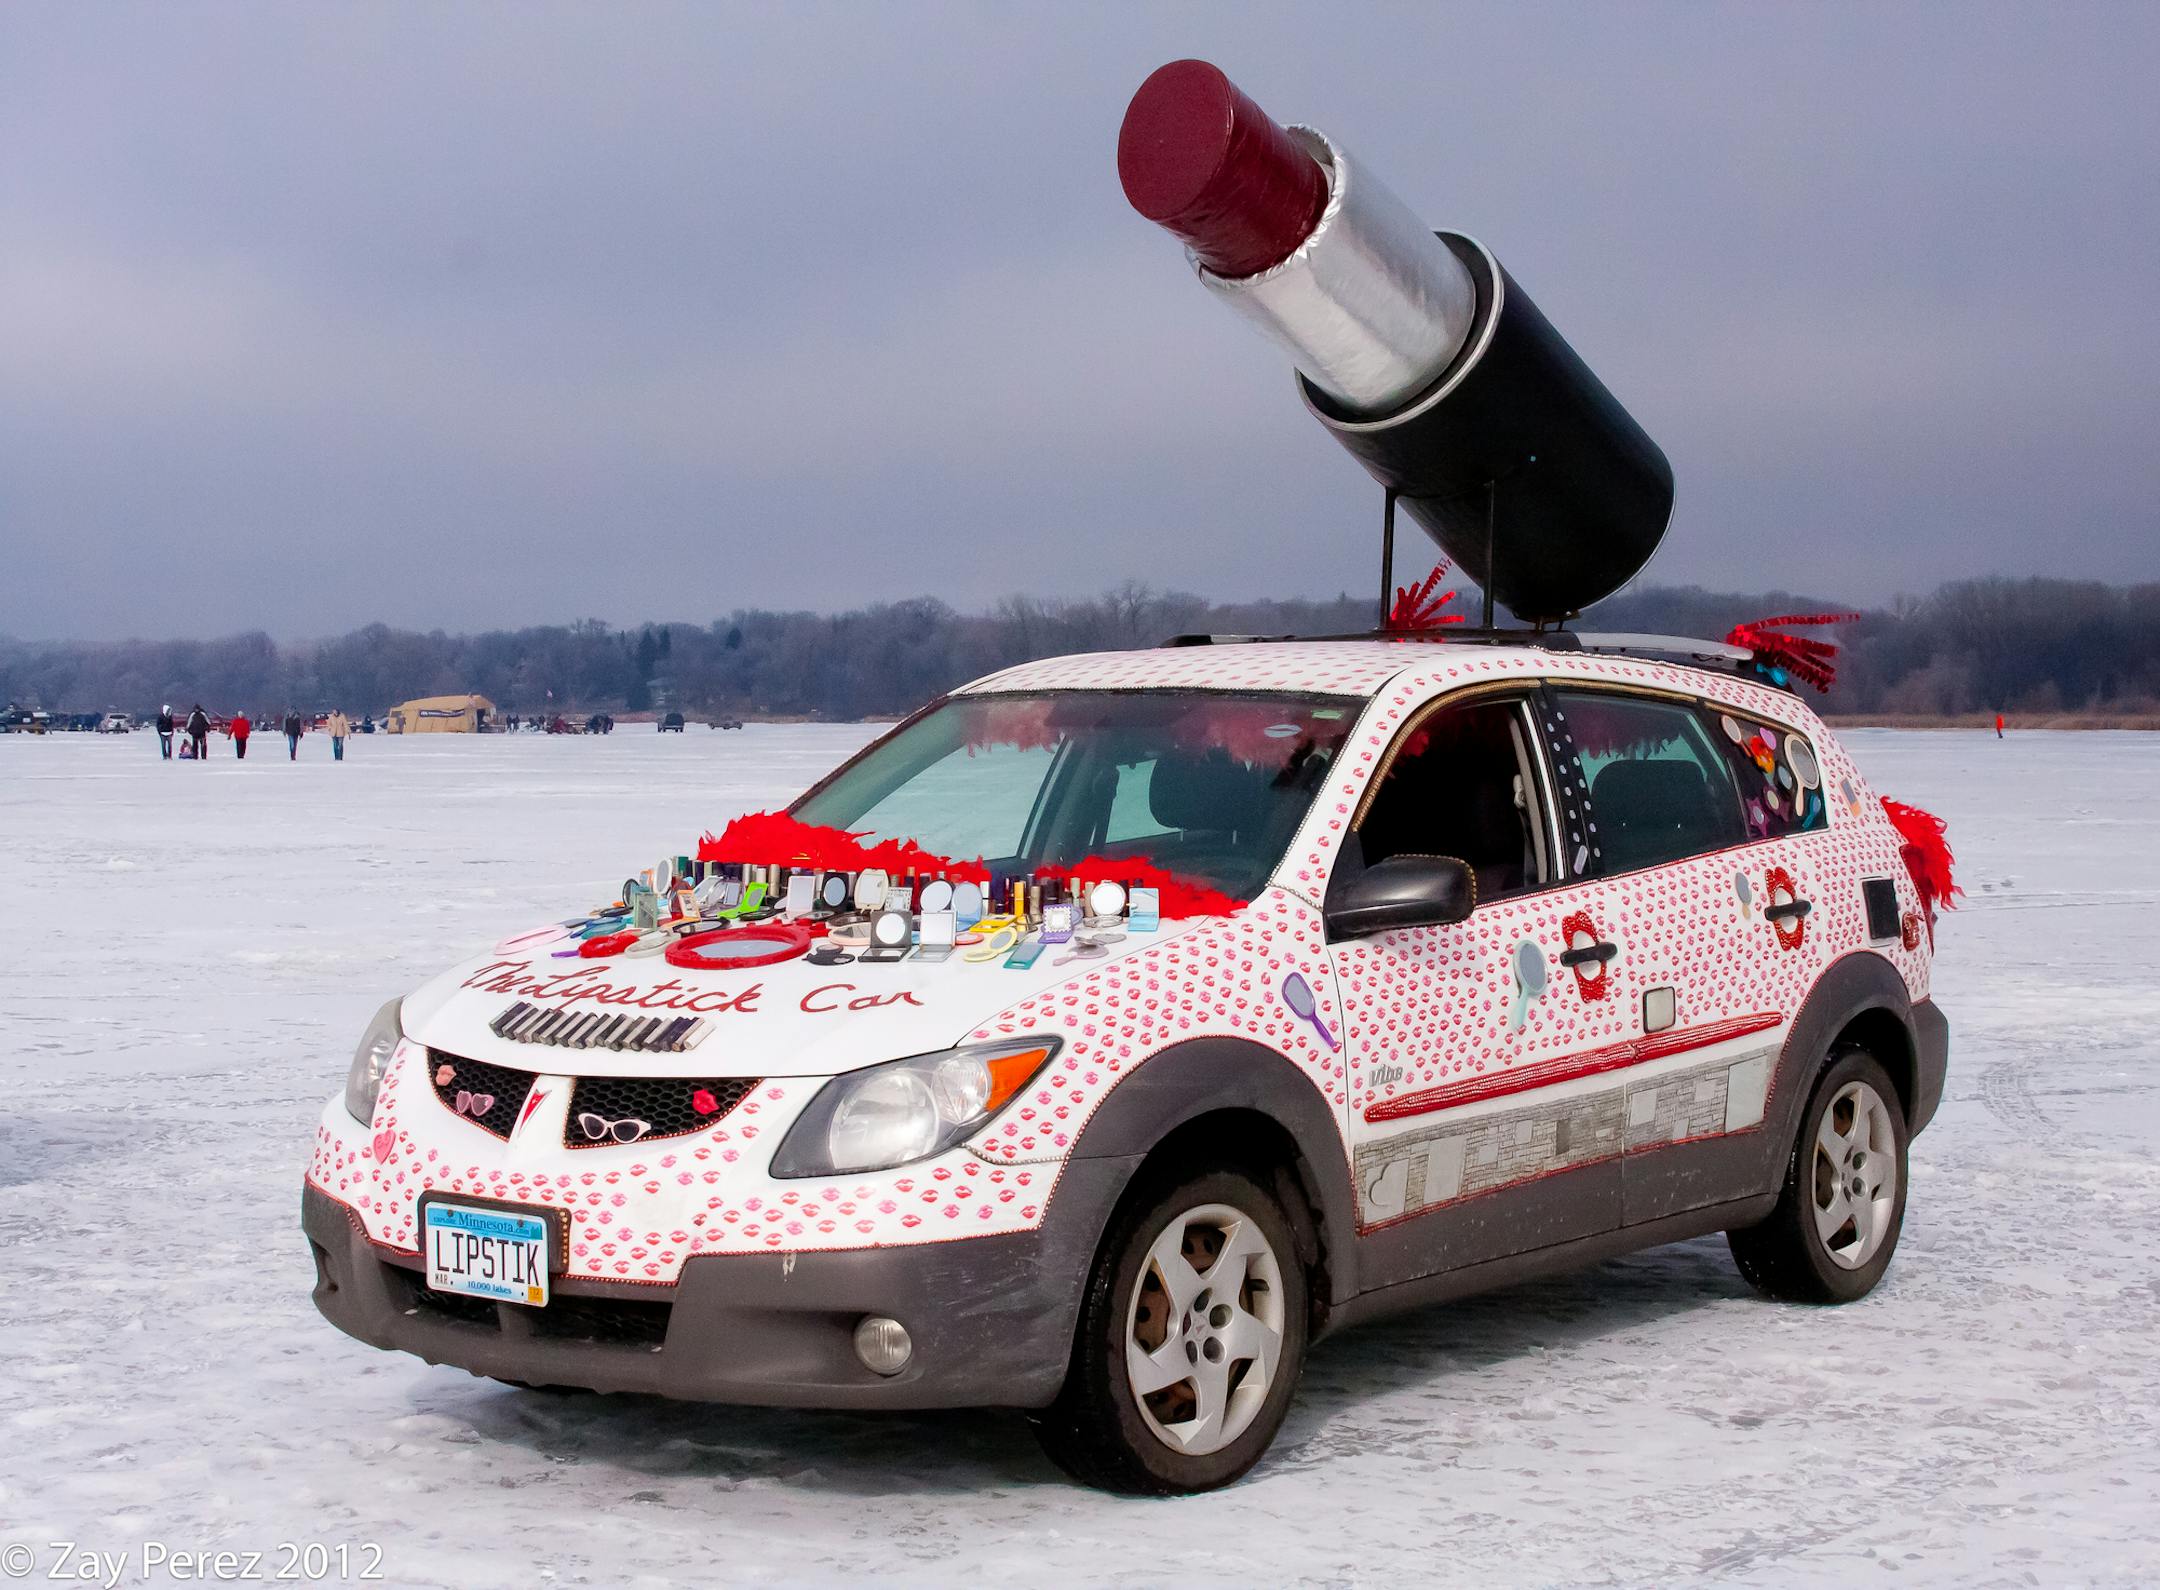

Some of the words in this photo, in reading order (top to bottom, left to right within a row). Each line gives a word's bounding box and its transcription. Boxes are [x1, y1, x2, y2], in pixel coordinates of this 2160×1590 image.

[460, 960, 534, 994] The
[517, 965, 764, 1013] Lipstick
[799, 983, 925, 1014] Car
[436, 1230, 540, 1287] LIPSTIK
